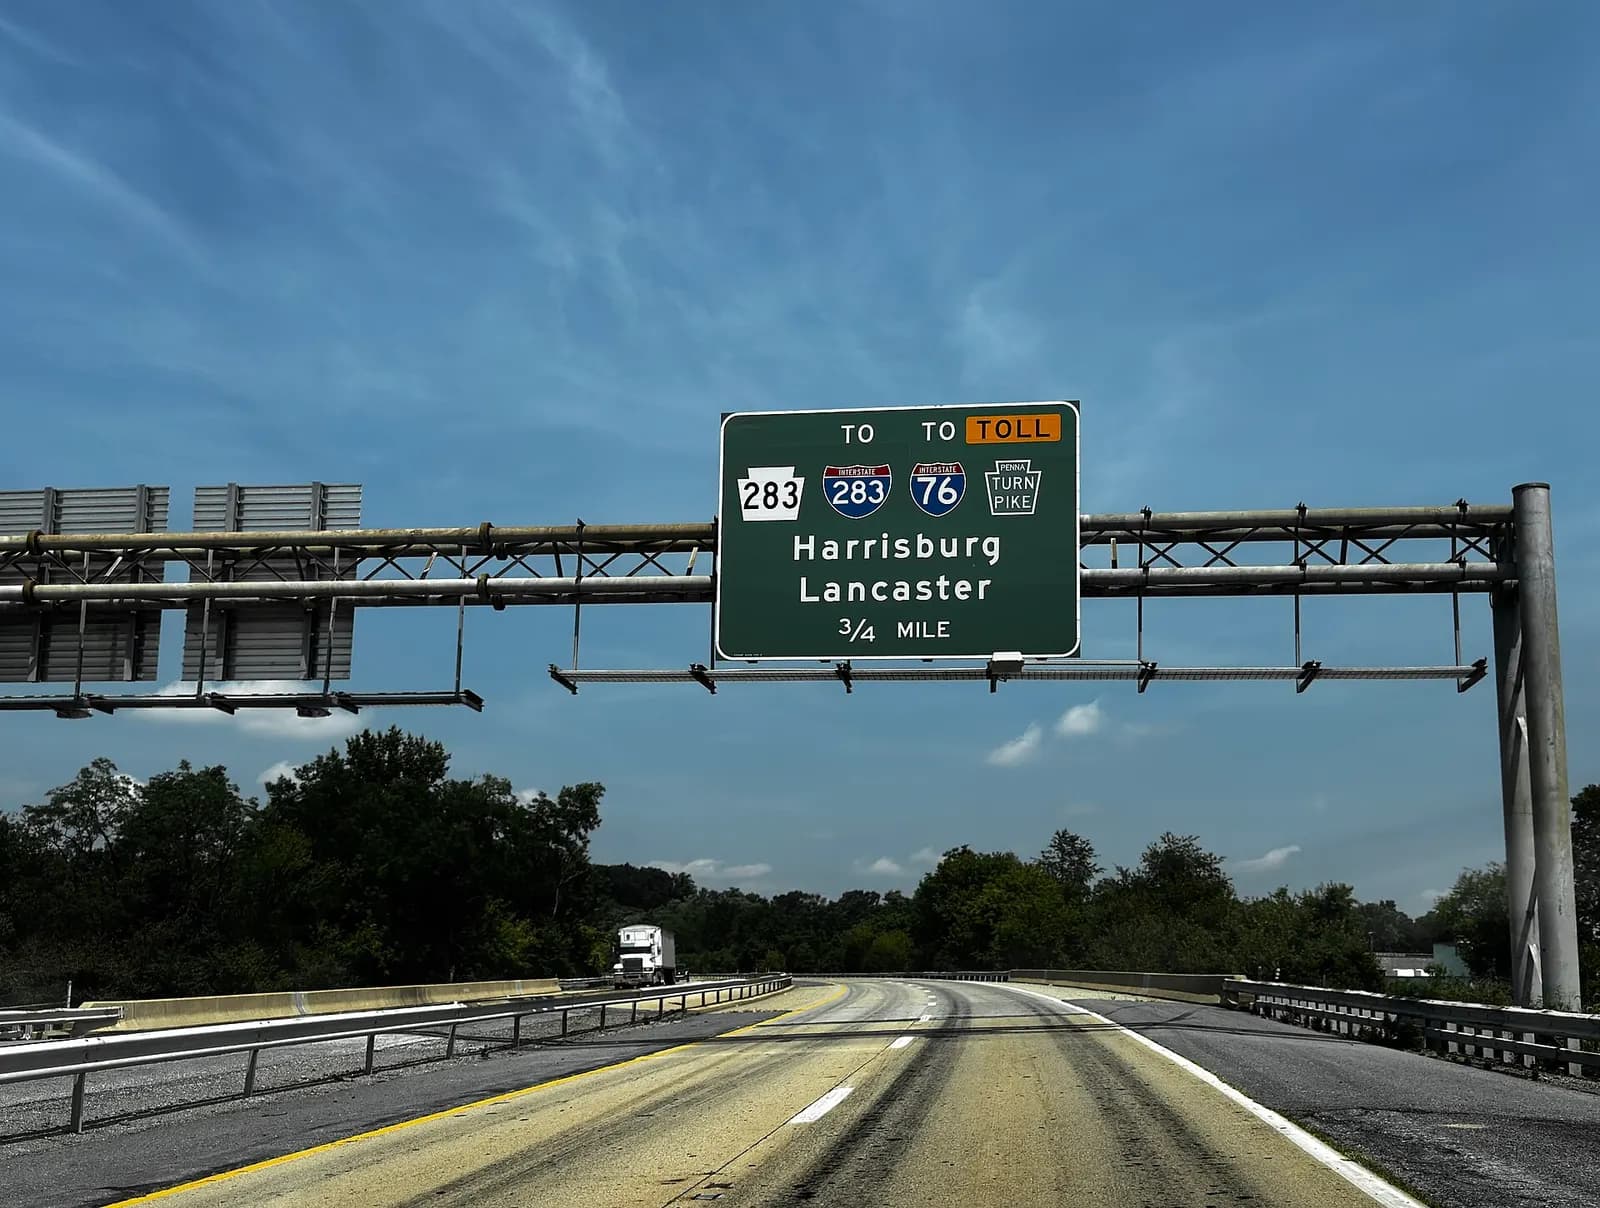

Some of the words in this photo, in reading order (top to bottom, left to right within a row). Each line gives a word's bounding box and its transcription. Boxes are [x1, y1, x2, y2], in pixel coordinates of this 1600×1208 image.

[841, 424, 875, 443] TO
[922, 421, 956, 441] TO
[976, 419, 1050, 440] TOLL
[838, 467, 876, 476] INTERSTATE
[919, 465, 957, 474] INTERSTATE
[1000, 463, 1026, 472] PENNA
[832, 480, 885, 505] 283
[917, 476, 959, 505] 76
[992, 476, 1034, 491] TURN
[743, 481, 798, 510] 283
[994, 495, 1031, 509] PIKE
[793, 532, 1000, 566] Harrisburg
[800, 574, 992, 602] Lancaster
[897, 621, 951, 639] MILE
